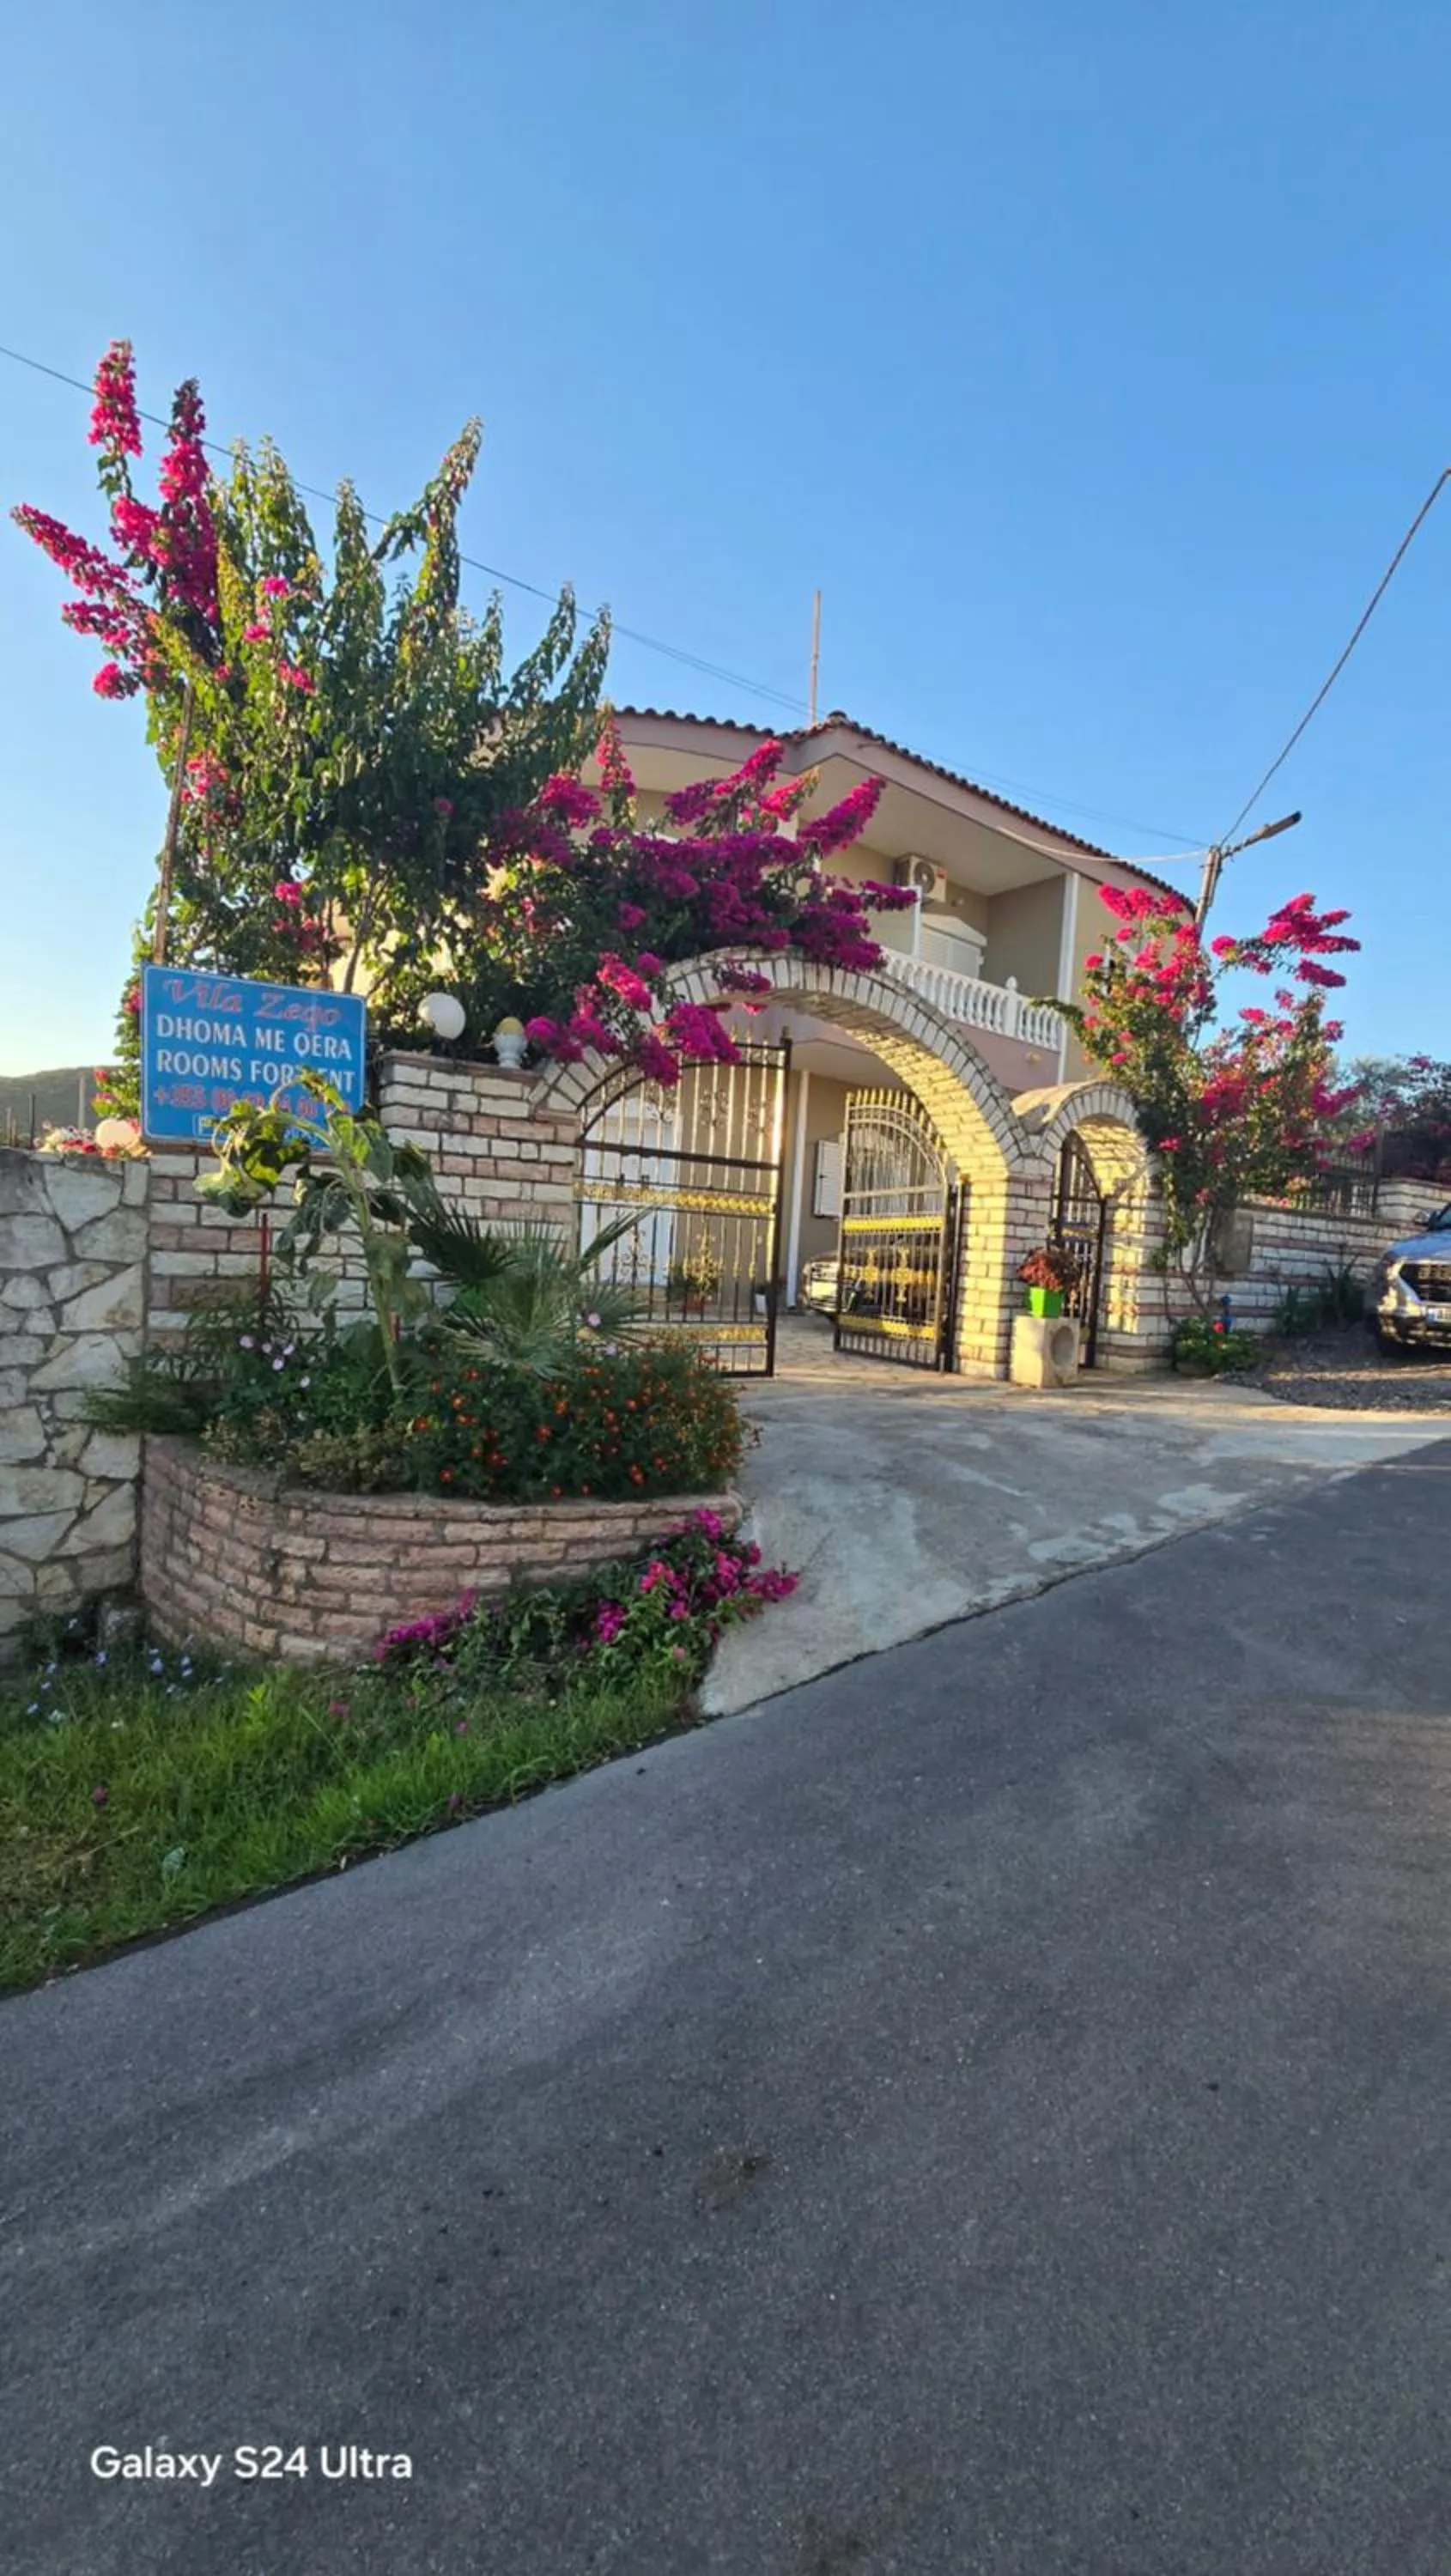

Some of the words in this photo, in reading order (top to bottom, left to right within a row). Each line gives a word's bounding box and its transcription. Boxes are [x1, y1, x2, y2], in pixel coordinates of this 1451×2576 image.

[162, 977, 243, 1013] Vila
[157, 1013, 247, 1048] DHOMA
[255, 1026, 285, 1053] ME
[157, 1048, 242, 1082] ROOMS
[250, 1060, 294, 1085] FOR
